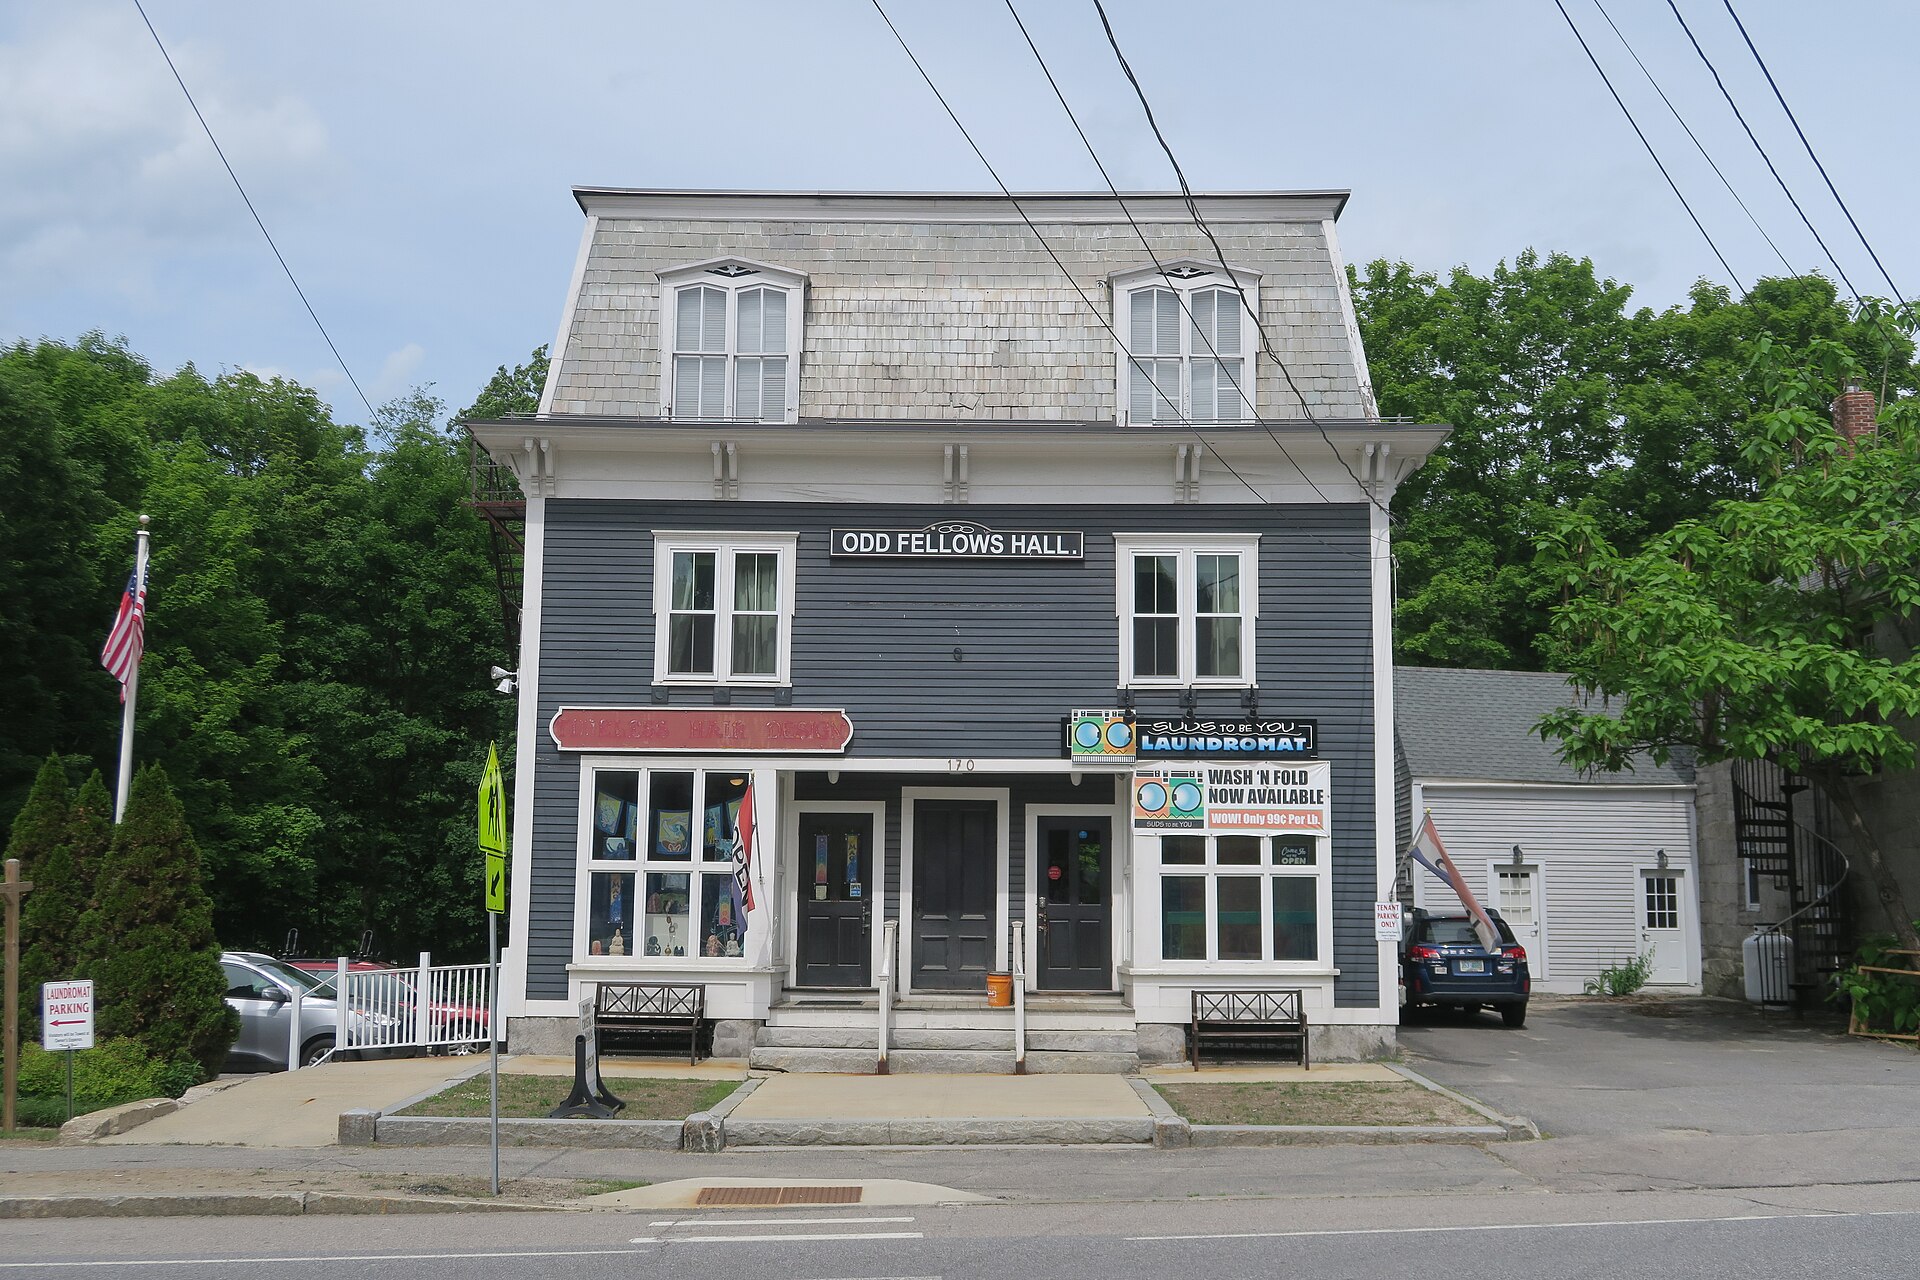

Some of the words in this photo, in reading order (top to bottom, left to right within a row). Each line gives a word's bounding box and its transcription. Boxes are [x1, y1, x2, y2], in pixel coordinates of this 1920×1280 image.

[842, 532, 890, 553] ODD
[897, 533, 1004, 554] FELLOWS
[1011, 534, 1077, 555] HALL.
[1219, 724, 1235, 733] TO
[1239, 725, 1253, 733] BE
[1256, 722, 1295, 733] YOU
[1141, 735, 1307, 751] LAUNDROMAT
[947, 759, 975, 771] 170
[1208, 769, 1253, 785] WASH
[1273, 770, 1309, 786] FOLD
[1208, 788, 1245, 804] NOW
[1247, 789, 1324, 805] AVAILABLE
[1211, 813, 1241, 824] WOW!
[1243, 813, 1265, 826] Only
[1288, 814, 1305, 825] Per
[1307, 814, 1321, 825] Lb.
[1281, 857, 1307, 865] OPEN
[46, 986, 90, 1000] LAUNDROMAT
[49, 1002, 89, 1015] PARKING
